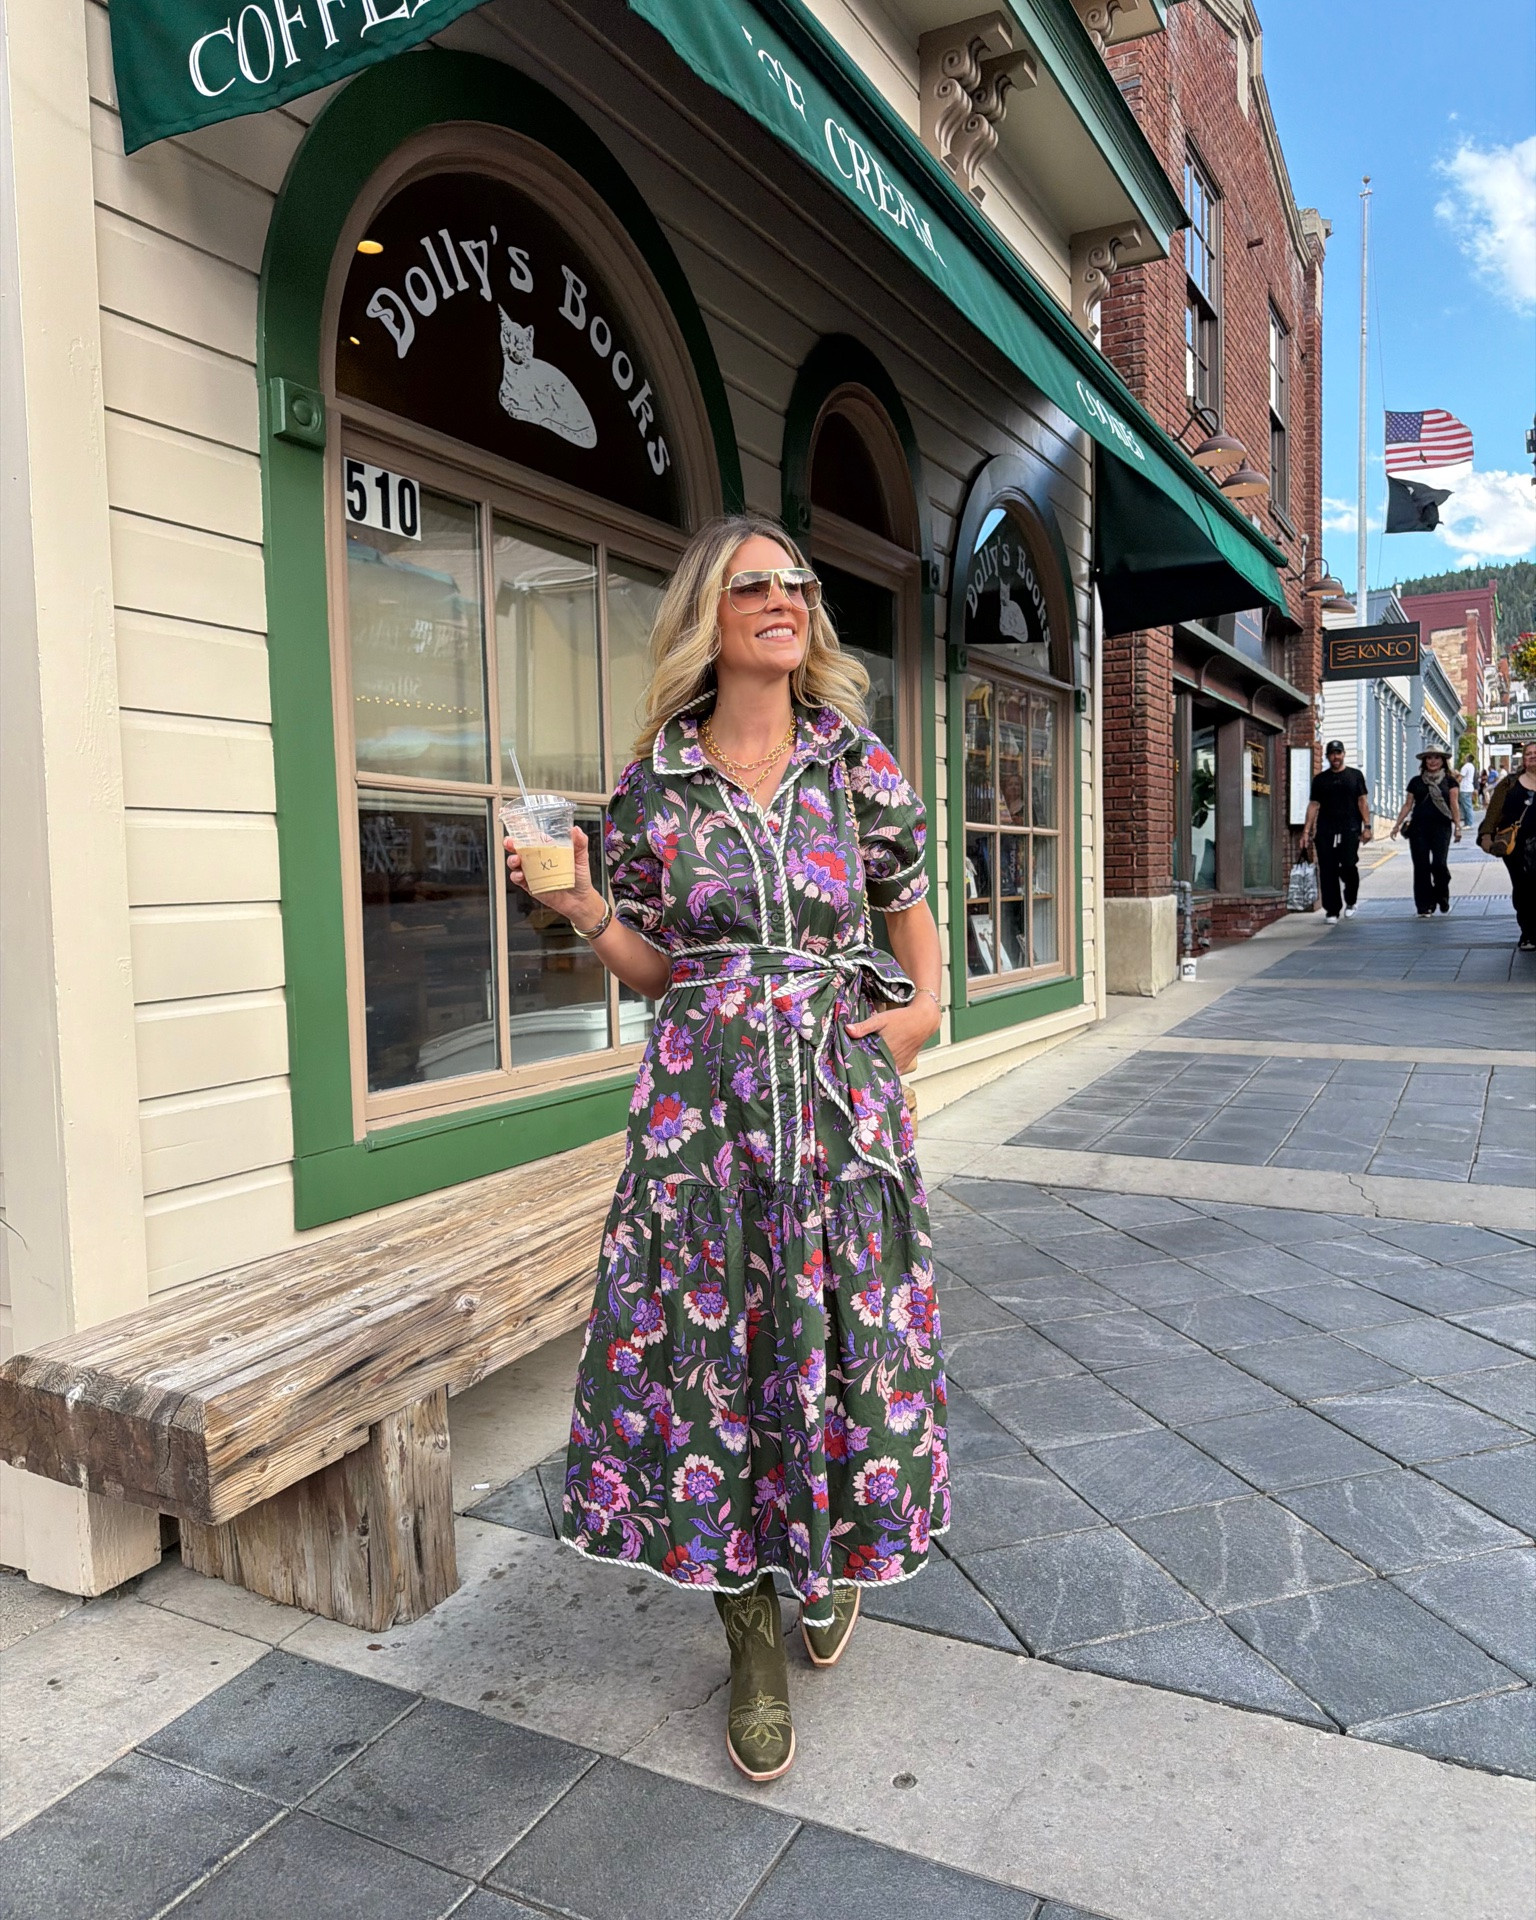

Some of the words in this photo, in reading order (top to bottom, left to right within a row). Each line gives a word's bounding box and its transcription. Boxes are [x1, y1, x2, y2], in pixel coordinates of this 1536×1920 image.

[189, 0, 430, 97] COFF
[741, 25, 807, 122] CE
[365, 225, 534, 359] Dolly's
[346, 458, 418, 537] 510
[966, 535, 1011, 619] Dolly's
